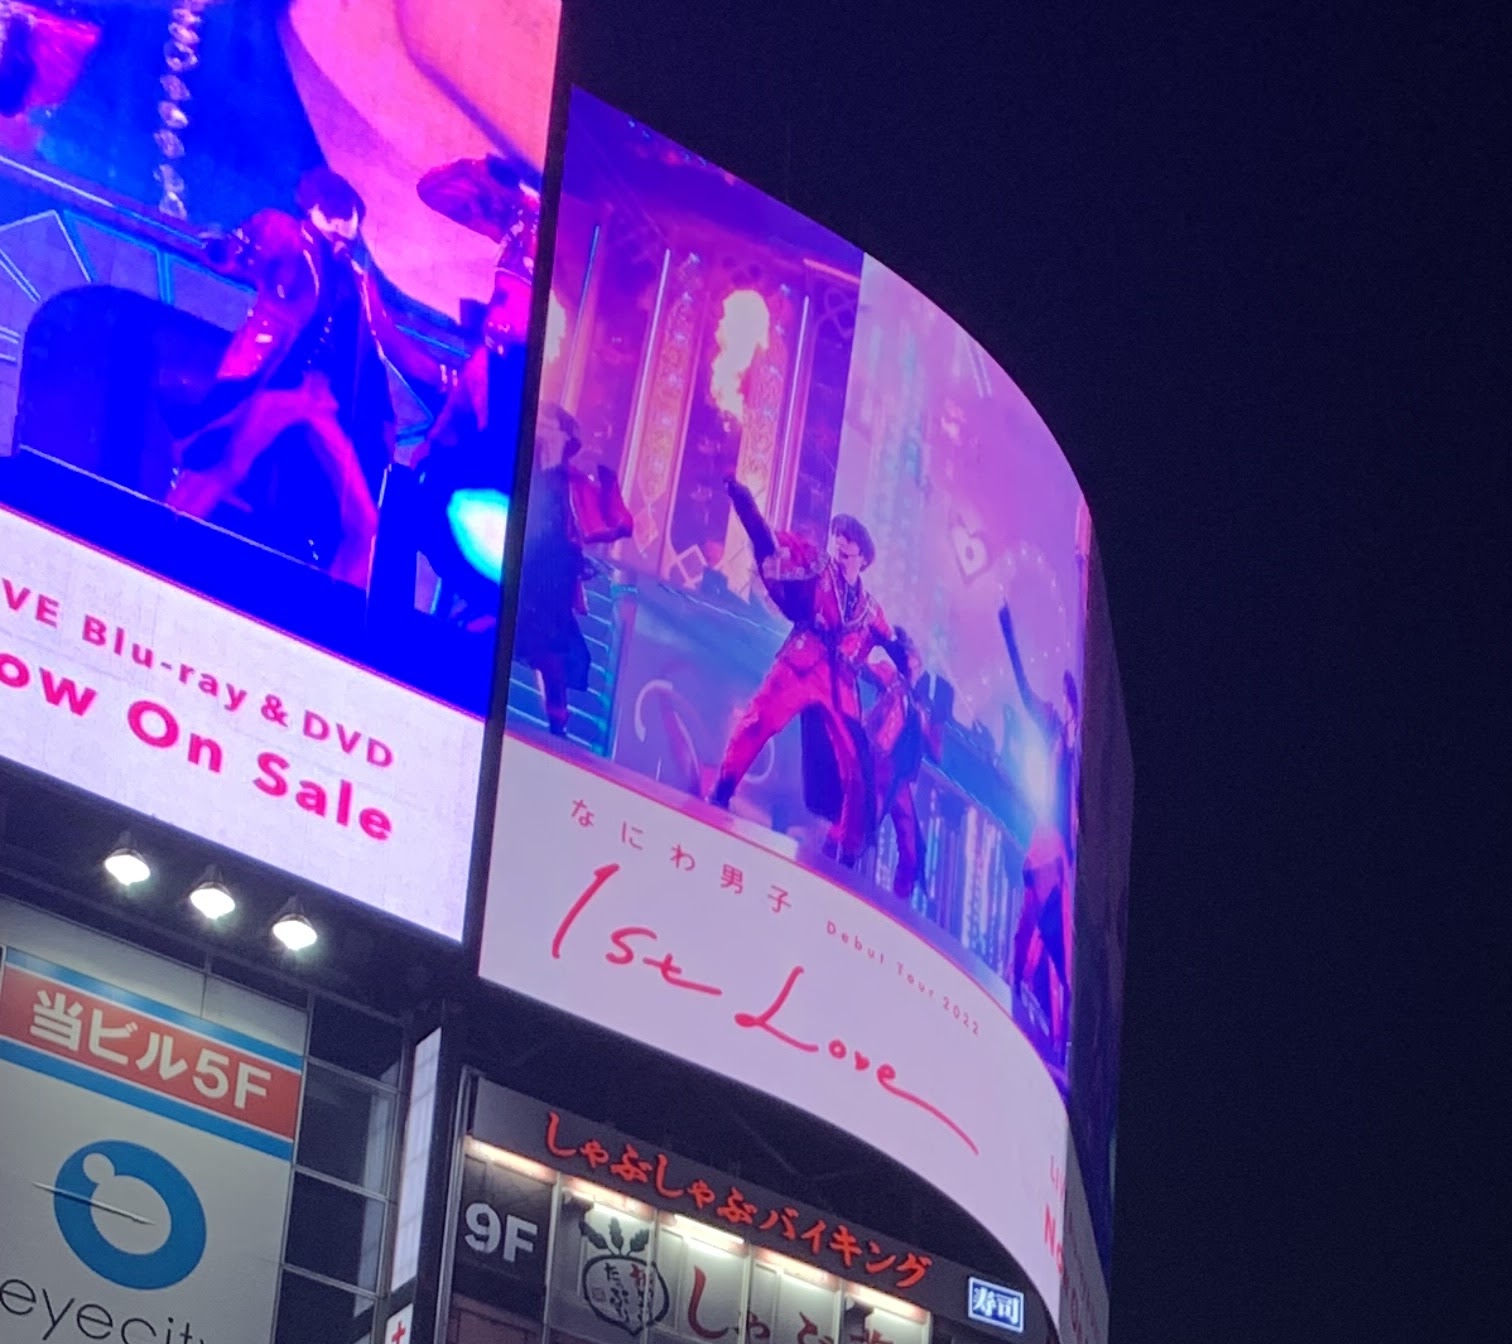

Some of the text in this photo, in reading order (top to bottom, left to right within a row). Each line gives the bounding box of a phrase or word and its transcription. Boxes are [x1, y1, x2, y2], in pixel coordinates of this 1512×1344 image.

[82, 613, 248, 712] Blu-ray
[260, 693, 289, 728] &
[303, 709, 394, 769] DVD
[127, 699, 224, 774] On
[252, 751, 394, 842] Sale
[570, 798, 793, 914] なにわ男子
[552, 862, 980, 1157] 1st Love
[826, 920, 885, 961] Debut
[942, 995, 982, 1037] 2022
[29, 988, 273, 1110] 当ビル5F
[464, 1202, 539, 1264] 9F
[544, 1111, 934, 1289] しゃぶしゃぶバイキング
[972, 1284, 1020, 1328] 寿司
